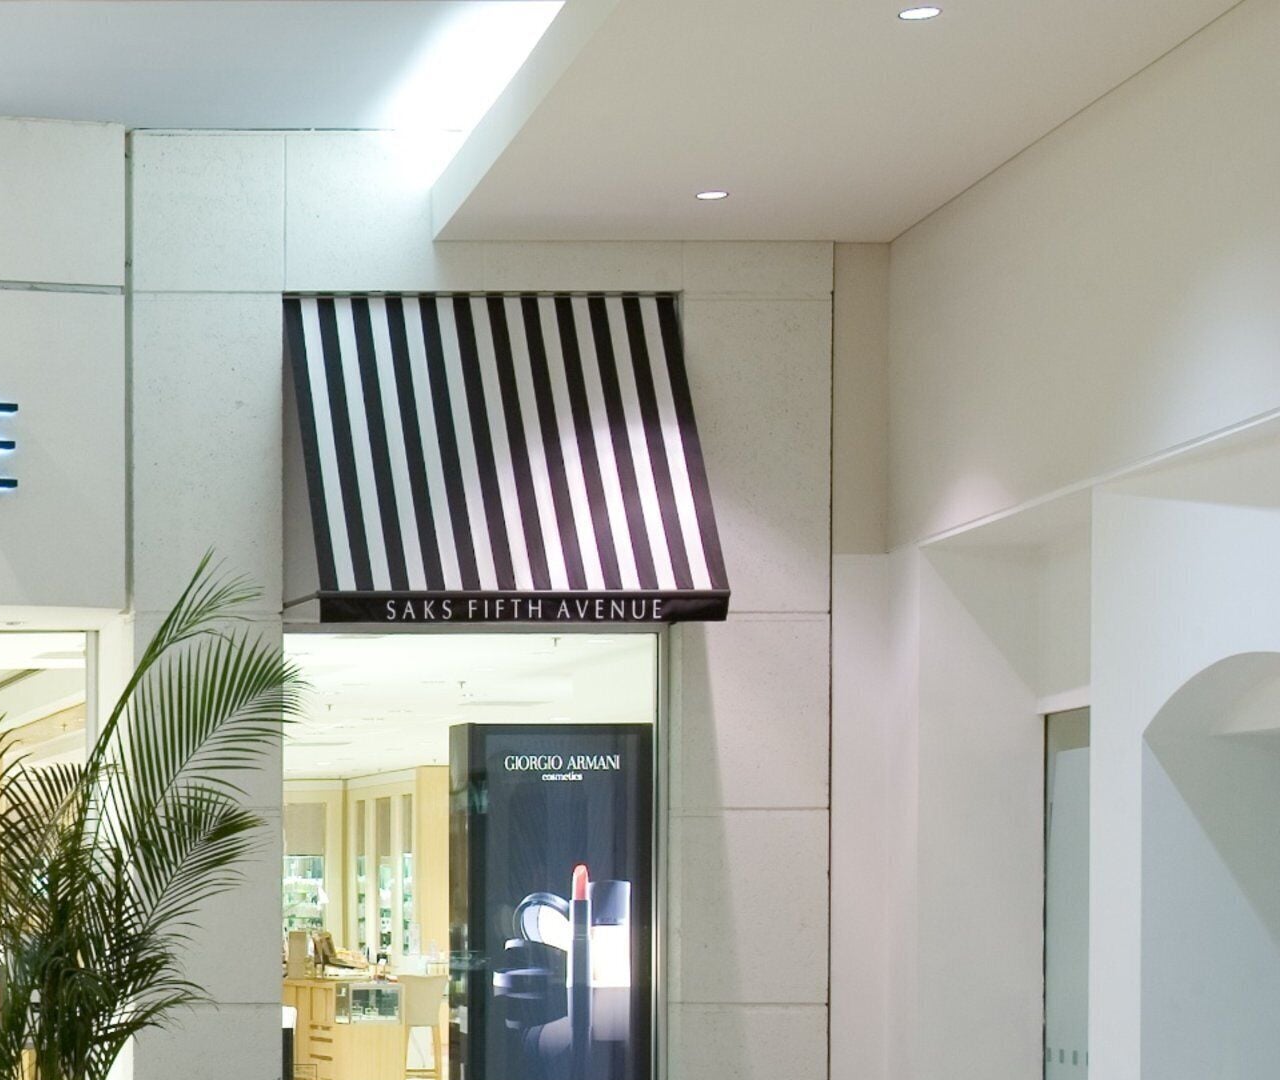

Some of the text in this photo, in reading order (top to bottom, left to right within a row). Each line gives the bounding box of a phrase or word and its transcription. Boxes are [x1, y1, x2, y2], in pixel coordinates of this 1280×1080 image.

[386, 599, 662, 620] SAKS FIFTH AVENUE
[504, 754, 620, 771] GIORGIO ARMANI
[541, 771, 583, 781] cosmetics
